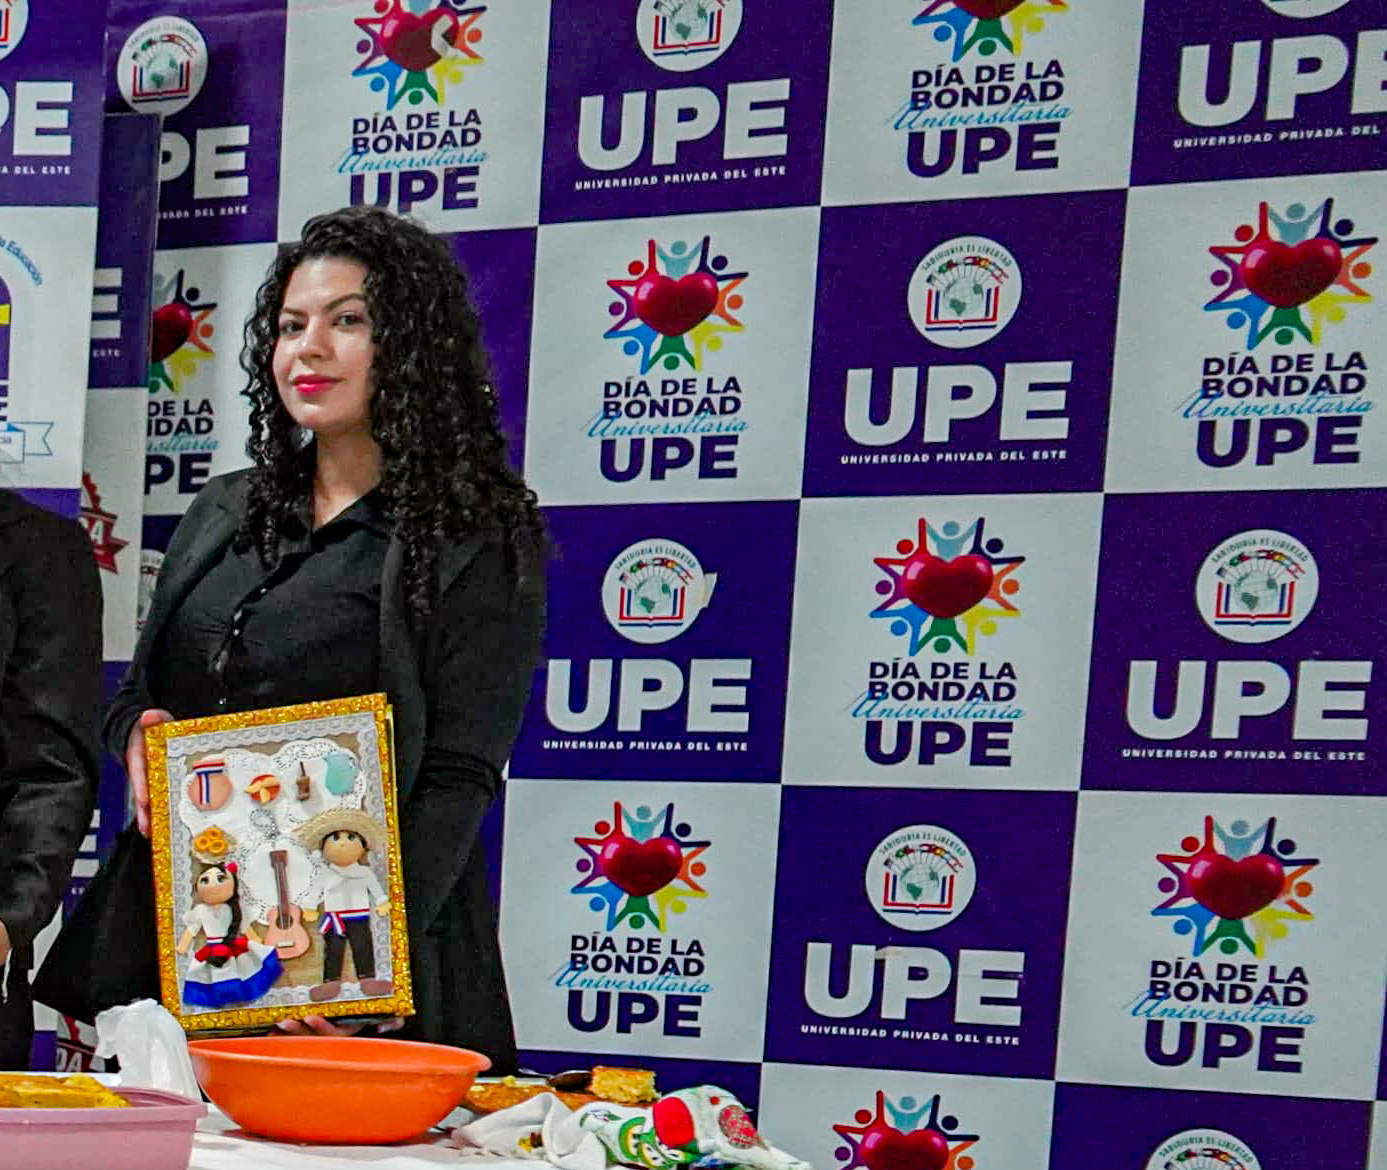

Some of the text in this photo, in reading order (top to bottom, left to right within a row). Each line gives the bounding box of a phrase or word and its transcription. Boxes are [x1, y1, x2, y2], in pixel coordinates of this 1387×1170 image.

[912, 59, 1064, 89] DÍA DE LA
[911, 80, 1064, 111] BONDAD
[353, 109, 481, 137] DÍA DE LA
[578, 78, 791, 172] UPE
[352, 127, 481, 154] BONDAD
[1173, 125, 1380, 149] UNIVERSIDAD PRIVADA DEL
[907, 124, 1059, 178] UPE
[14, 166, 35, 175] DEL
[41, 165, 70, 175] ESTE
[575, 165, 785, 190] UNIVERSIDAD PRIVADA DEL ESTE
[349, 167, 479, 213] UPE
[1203, 351, 1367, 377] DÍA DE LA
[604, 376, 742, 399] DÍA DE LA
[1203, 372, 1366, 398] BONDAD
[604, 395, 742, 419] BONDAD
[844, 361, 1073, 446] UPE
[1197, 417, 1362, 468] UPE
[600, 434, 738, 484] UPE
[841, 449, 1067, 465] UNIVERSIDAD PRIVADA DEL ESTE
[870, 657, 1016, 680] DÍA DE LA
[544, 658, 752, 733] UPE
[869, 681, 1016, 703] BONDAD
[1126, 659, 1373, 741] UPE
[543, 740, 747, 751] UNIVERSIDAD PRIVADA DEL ESTE
[865, 720, 1012, 767] UPE
[1122, 748, 1365, 761] UNIVERSIDAD PRIVADA DEL ESTE
[571, 931, 705, 956] DÍA DE LA
[570, 952, 705, 977] BONDAD
[1150, 957, 1309, 986] DÍA DE LA
[803, 942, 1025, 1026] UPE
[1150, 981, 1308, 1007] BONDAD
[567, 989, 702, 1038] UPE
[801, 1024, 1019, 1045] UNIVERSIDAD PRIVADA DEL ESTE
[1145, 1020, 1304, 1073] UPE
